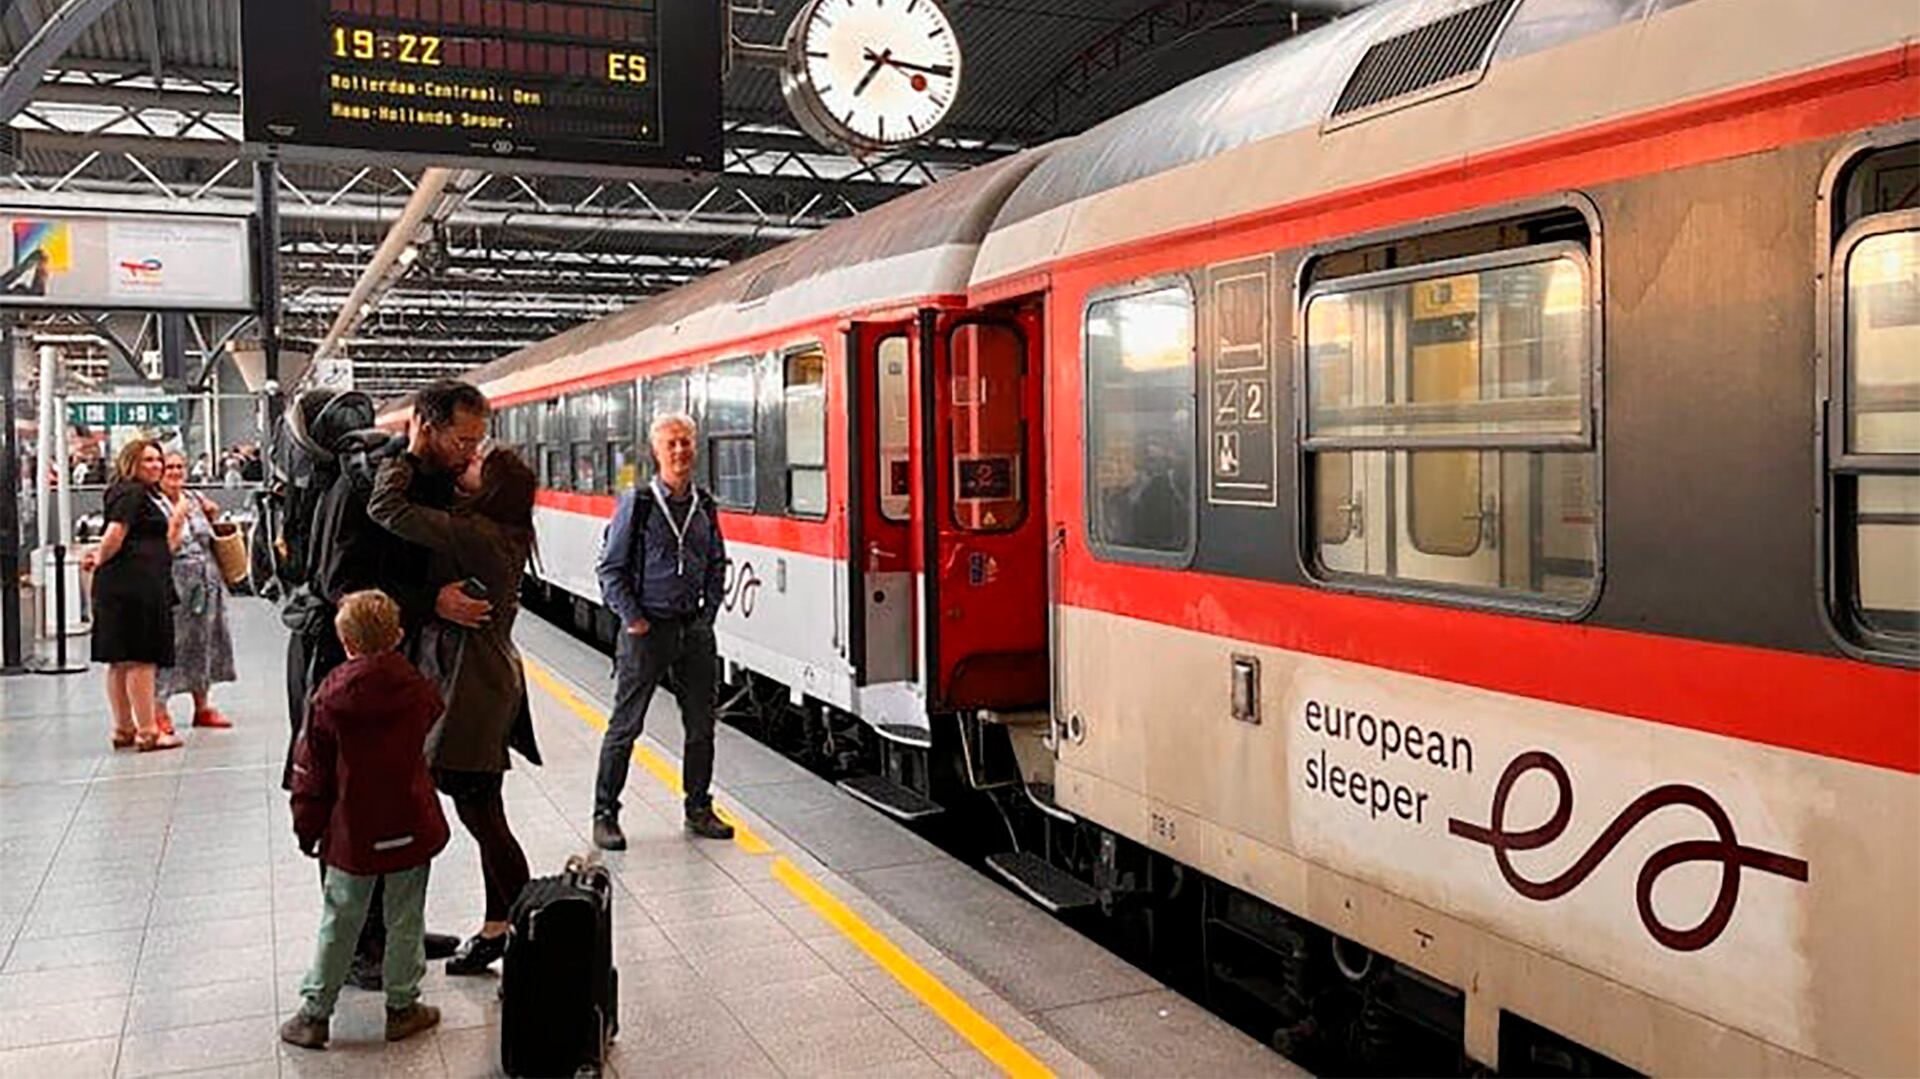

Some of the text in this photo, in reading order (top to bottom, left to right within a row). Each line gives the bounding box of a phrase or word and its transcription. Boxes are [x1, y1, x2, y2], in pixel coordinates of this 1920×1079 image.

[333, 28, 441, 65] 19:22
[608, 54, 647, 82] ES
[513, 89, 541, 105] Den
[1247, 384, 1262, 419] 2
[1305, 699, 1473, 774] european
[1306, 748, 1430, 824] sleeper
